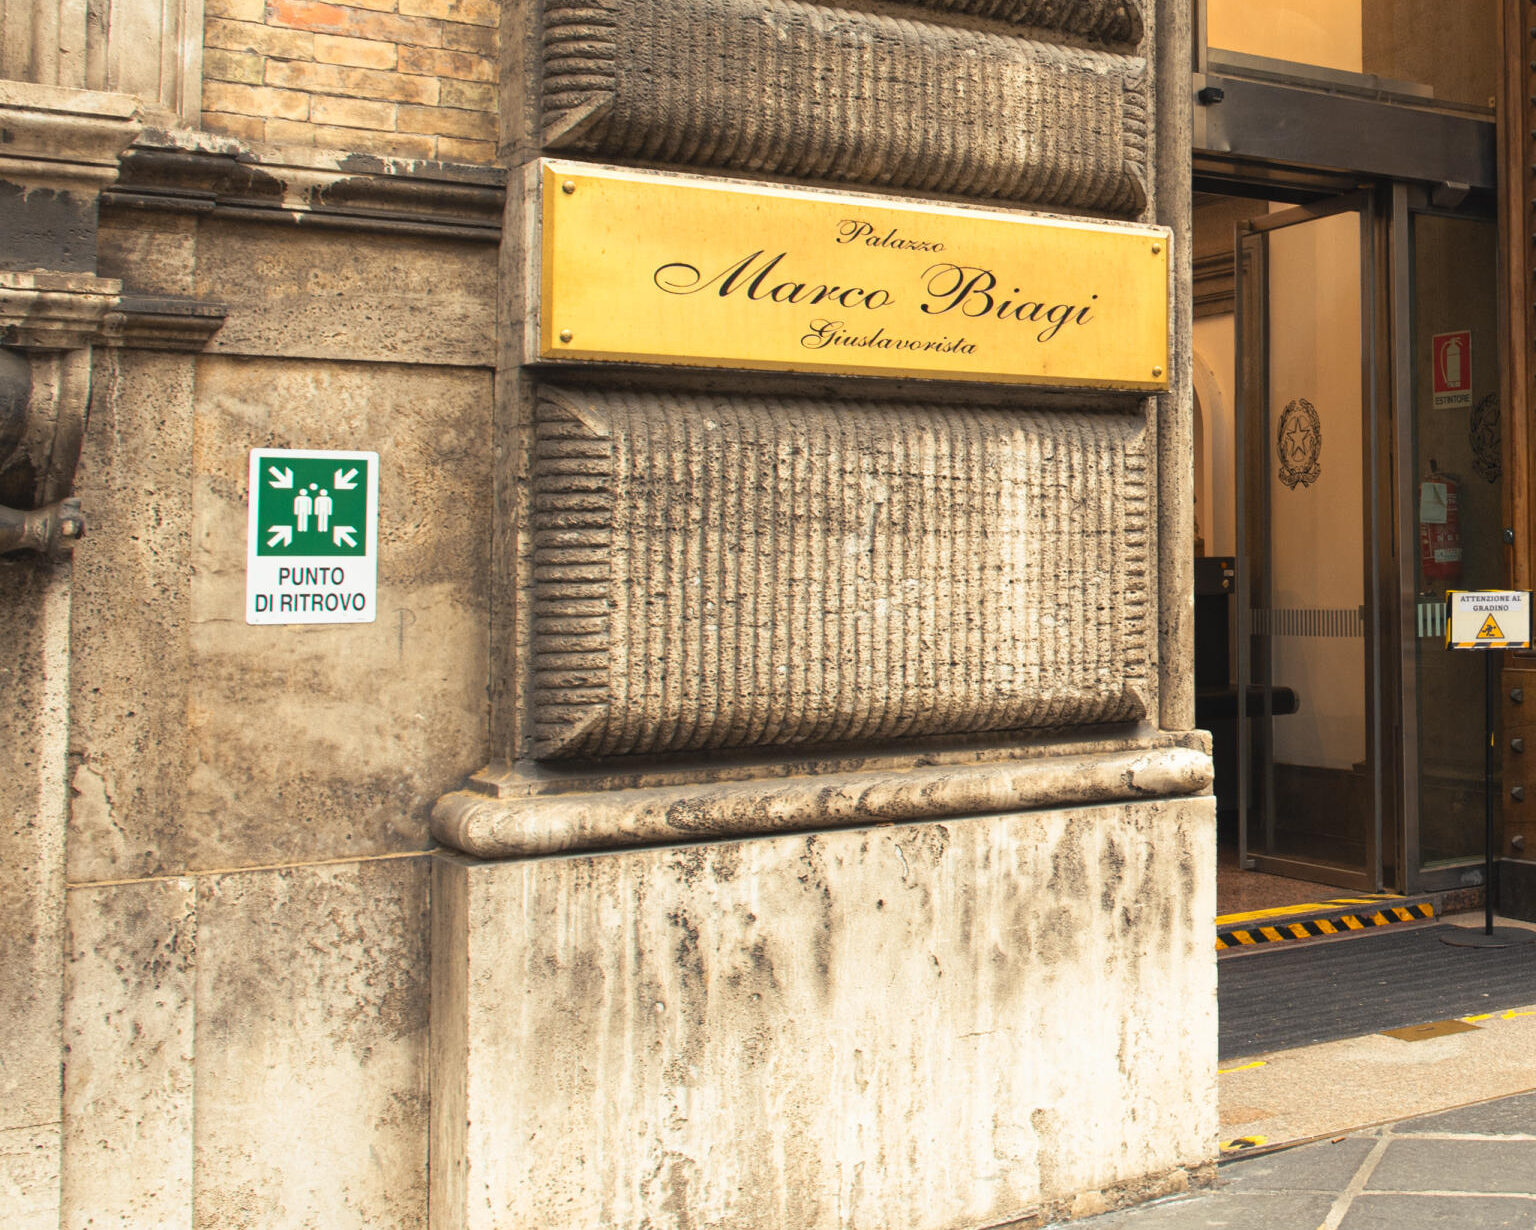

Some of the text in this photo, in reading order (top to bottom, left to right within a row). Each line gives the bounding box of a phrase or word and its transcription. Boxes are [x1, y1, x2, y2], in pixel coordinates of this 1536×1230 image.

[837, 218, 947, 253] Palazzo
[652, 249, 1099, 343] Marco Biagi
[799, 318, 979, 355] Giuslavorista
[1435, 393, 1470, 405] ESTINTORE
[278, 566, 345, 586] PUNTO
[255, 592, 366, 612] DI RITROVO
[1472, 604, 1509, 612] GRADINO
